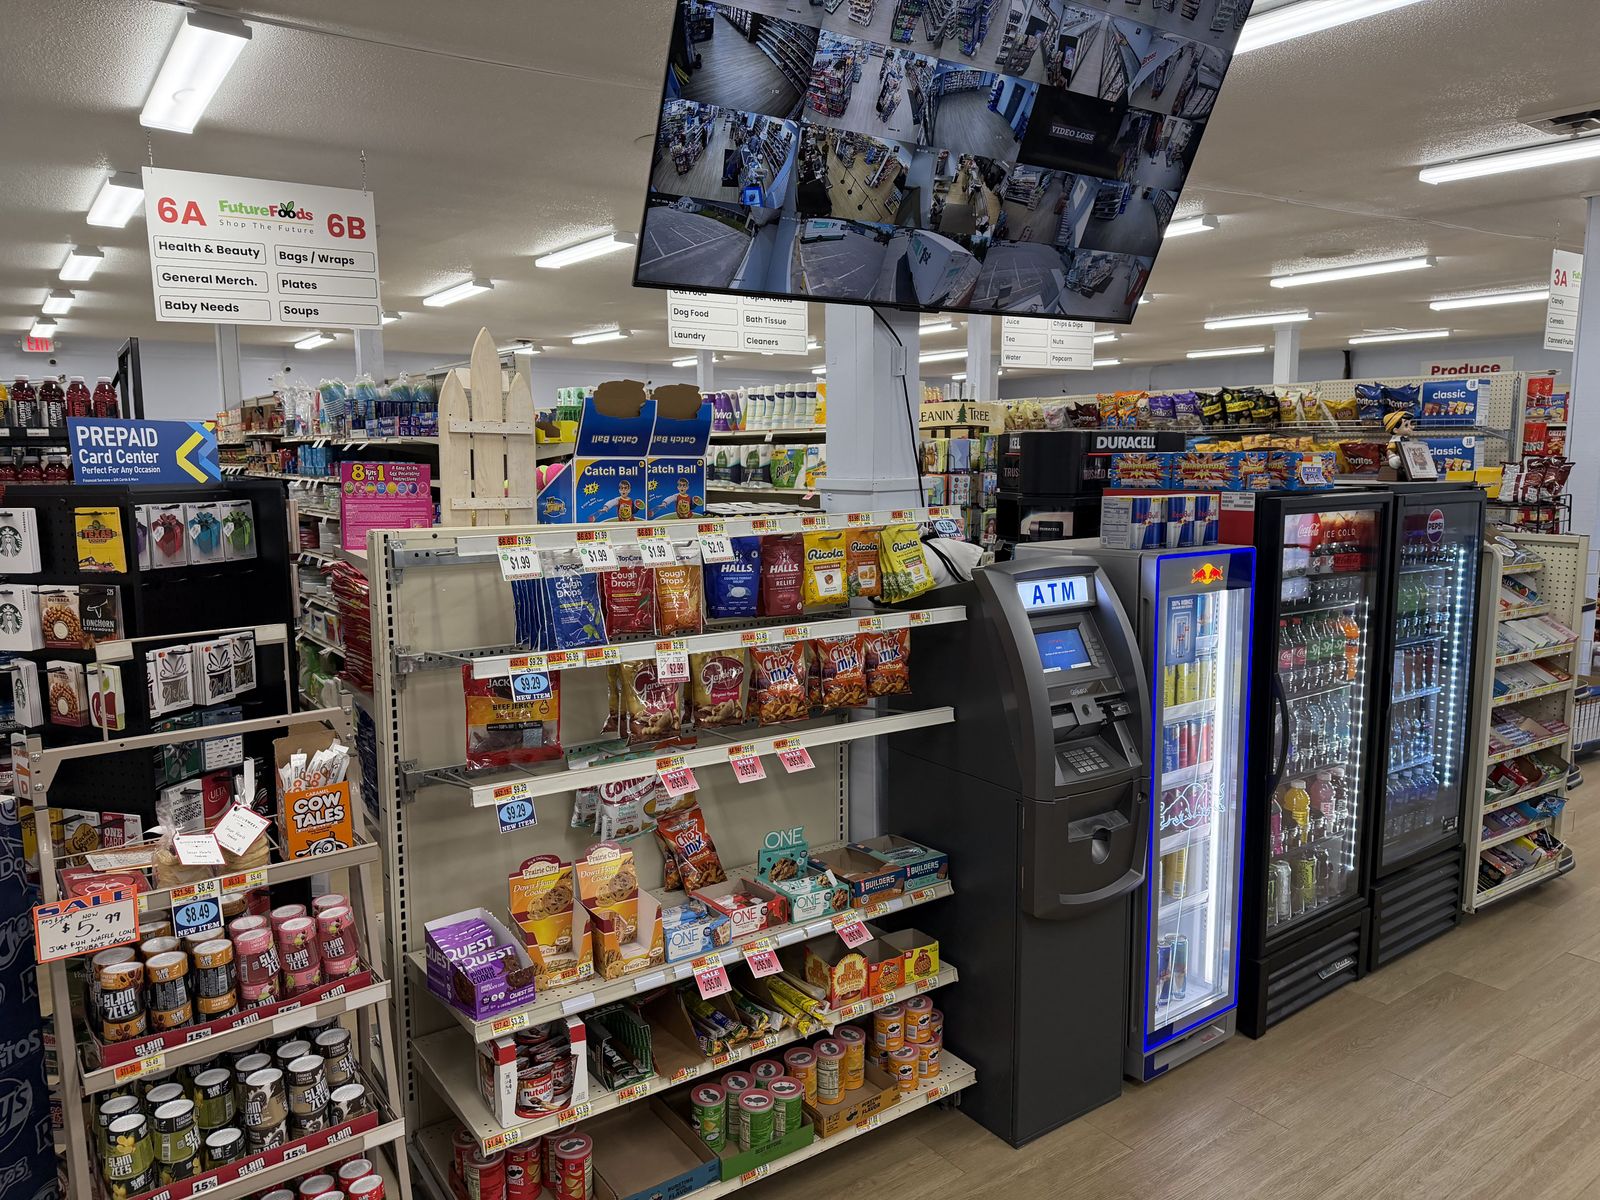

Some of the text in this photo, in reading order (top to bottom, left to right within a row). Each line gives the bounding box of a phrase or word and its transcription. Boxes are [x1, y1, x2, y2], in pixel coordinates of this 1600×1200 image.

[1052, 125, 1095, 142] VIDEO LOSS
[157, 196, 366, 240] 6A FutureFoods 6B
[219, 218, 315, 235] Shop The Future
[159, 241, 260, 259] Health & Beauty
[279, 251, 355, 267] Bags / Wraps
[162, 272, 258, 287] General Merch.
[1554, 268, 1568, 288] 3A
[282, 280, 318, 290] Plates
[164, 300, 240, 314] Baby Needs
[1552, 297, 1564, 307] Candy
[284, 305, 320, 318] Soups
[673, 308, 710, 318] Dog Food
[746, 315, 786, 326] Bath Tissue
[1052, 320, 1067, 329] Chips
[1072, 322, 1084, 330] Dips
[674, 331, 706, 342] Laundry
[746, 338, 779, 346] Cleaners
[1548, 336, 1574, 346] Canned Fruits
[1052, 355, 1073, 363] Popcorn
[1431, 362, 1501, 376] Produce
[1432, 389, 1466, 400] classic
[968, 408, 990, 422] TREE
[76, 425, 158, 448] PREPAID
[612, 434, 638, 444] Catch
[1096, 436, 1156, 450] DURACELL
[78, 448, 160, 465] Card Center
[82, 466, 161, 476] Perfect For Any Occasion
[351, 464, 386, 481] 8 1
[584, 466, 638, 476] Catch Ball
[677, 464, 696, 474] Ball
[1427, 522, 1444, 530] PEPSI
[82, 529, 113, 540] TEXAS
[1324, 528, 1356, 538] ICE COLD
[648, 545, 666, 559] $1.99
[707, 541, 725, 554] $2.19
[850, 542, 880, 552] Ricola
[588, 549, 608, 563] $1.99
[808, 548, 844, 561] Ricola
[509, 555, 532, 571] $1.99
[770, 564, 800, 574] HALLS
[610, 571, 638, 580] Cough
[659, 570, 686, 579] Cough
[555, 579, 583, 590] Cough
[611, 578, 636, 588] Drops
[556, 588, 582, 599] Drops
[1032, 580, 1076, 605] ATM
[82, 618, 115, 628] LONGHORN
[872, 634, 898, 653] Chex
[566, 653, 580, 662] $6.99
[604, 650, 617, 659] $6.39
[830, 641, 857, 663] Chex
[668, 662, 684, 674] $2.99
[762, 652, 794, 674] Chex
[770, 664, 795, 684] mix
[835, 672, 862, 680] CHEDDAR
[487, 679, 510, 689] JACK
[521, 676, 541, 692] $9.29
[492, 702, 535, 712] BEEF JERKY
[736, 758, 754, 766] SALE
[210, 786, 227, 799] ULTA
[305, 788, 330, 797] CARAMEL
[293, 791, 342, 814] COW
[292, 805, 346, 829] TALES
[506, 804, 526, 819] $9.29
[502, 819, 536, 832] NEW ITEM
[104, 828, 123, 838] ONE
[764, 826, 804, 849] ONE
[104, 837, 123, 848] CARD
[684, 834, 706, 858] mix
[588, 850, 619, 863] Prairie City
[524, 864, 558, 877] Prairie City
[580, 868, 600, 878] Down
[910, 860, 940, 875] BUILDERS
[250, 872, 262, 881] $5.49
[865, 875, 896, 890] BUILDERS
[198, 882, 215, 893] $8.49
[514, 882, 535, 894] Down
[38, 888, 134, 917] SALE
[82, 911, 99, 920] NOW
[185, 903, 210, 923] $8.49
[732, 906, 758, 925] ONE
[62, 922, 70, 934] $
[104, 911, 122, 924] 99
[177, 921, 220, 938] NEW ITEM
[671, 926, 700, 946] ONE
[70, 938, 87, 948] FUN
[90, 932, 114, 942] WAFFLE
[444, 936, 494, 962] QUEST
[286, 948, 309, 964] SLAM
[462, 946, 514, 970] QUEST
[289, 960, 310, 972] ZEES
[470, 965, 494, 980] PROTEIN
[578, 964, 592, 974] $2.29
[473, 973, 496, 985] COOKIE
[104, 988, 136, 1008] SLAM
[108, 1002, 136, 1020] ZEES
[511, 1015, 525, 1025] $3.29
[524, 1083, 552, 1098] nutella
[620, 1088, 635, 1099] $1.84
[576, 1105, 590, 1115] $3.69
[862, 1102, 881, 1116] FLAVOR
[487, 1131, 519, 1148] $1.84 $3.69
[284, 1146, 308, 1160] 15%
[194, 1177, 218, 1194] 15%
[668, 1176, 694, 1192] BURSTING
[668, 1186, 694, 1200] FLAVOR
